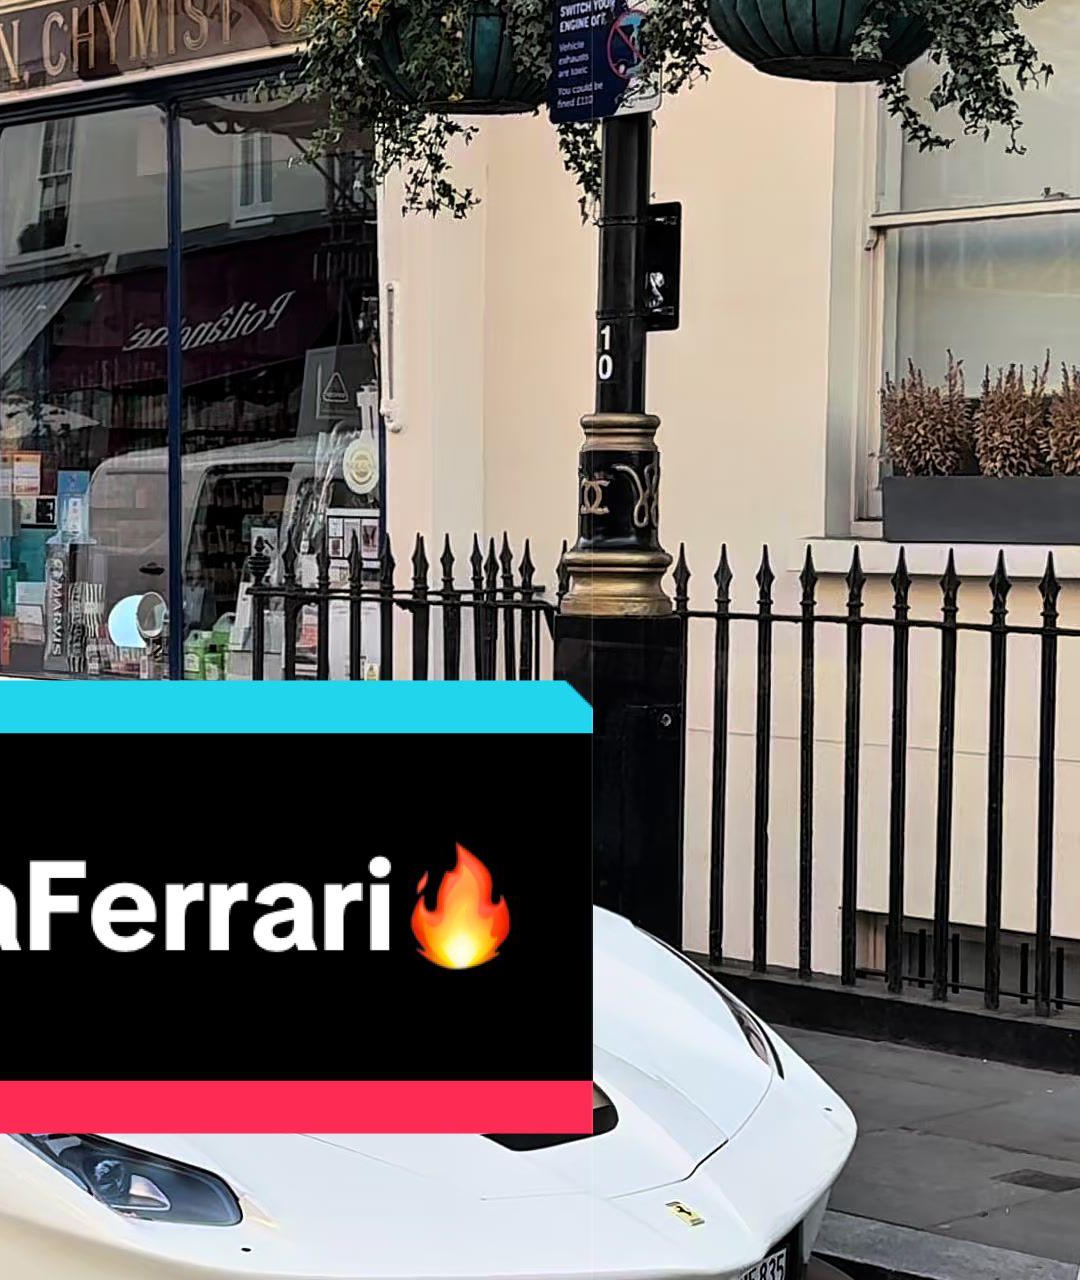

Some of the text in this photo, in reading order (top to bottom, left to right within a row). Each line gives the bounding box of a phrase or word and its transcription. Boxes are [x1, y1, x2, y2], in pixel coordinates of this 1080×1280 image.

[560, 1, 592, 18] SWITCH
[560, 18, 589, 33] ENGINE
[559, 41, 585, 52] Vehicle
[558, 87, 571, 97] You
[572, 82, 593, 94] could
[52, 579, 62, 655] MARVIS
